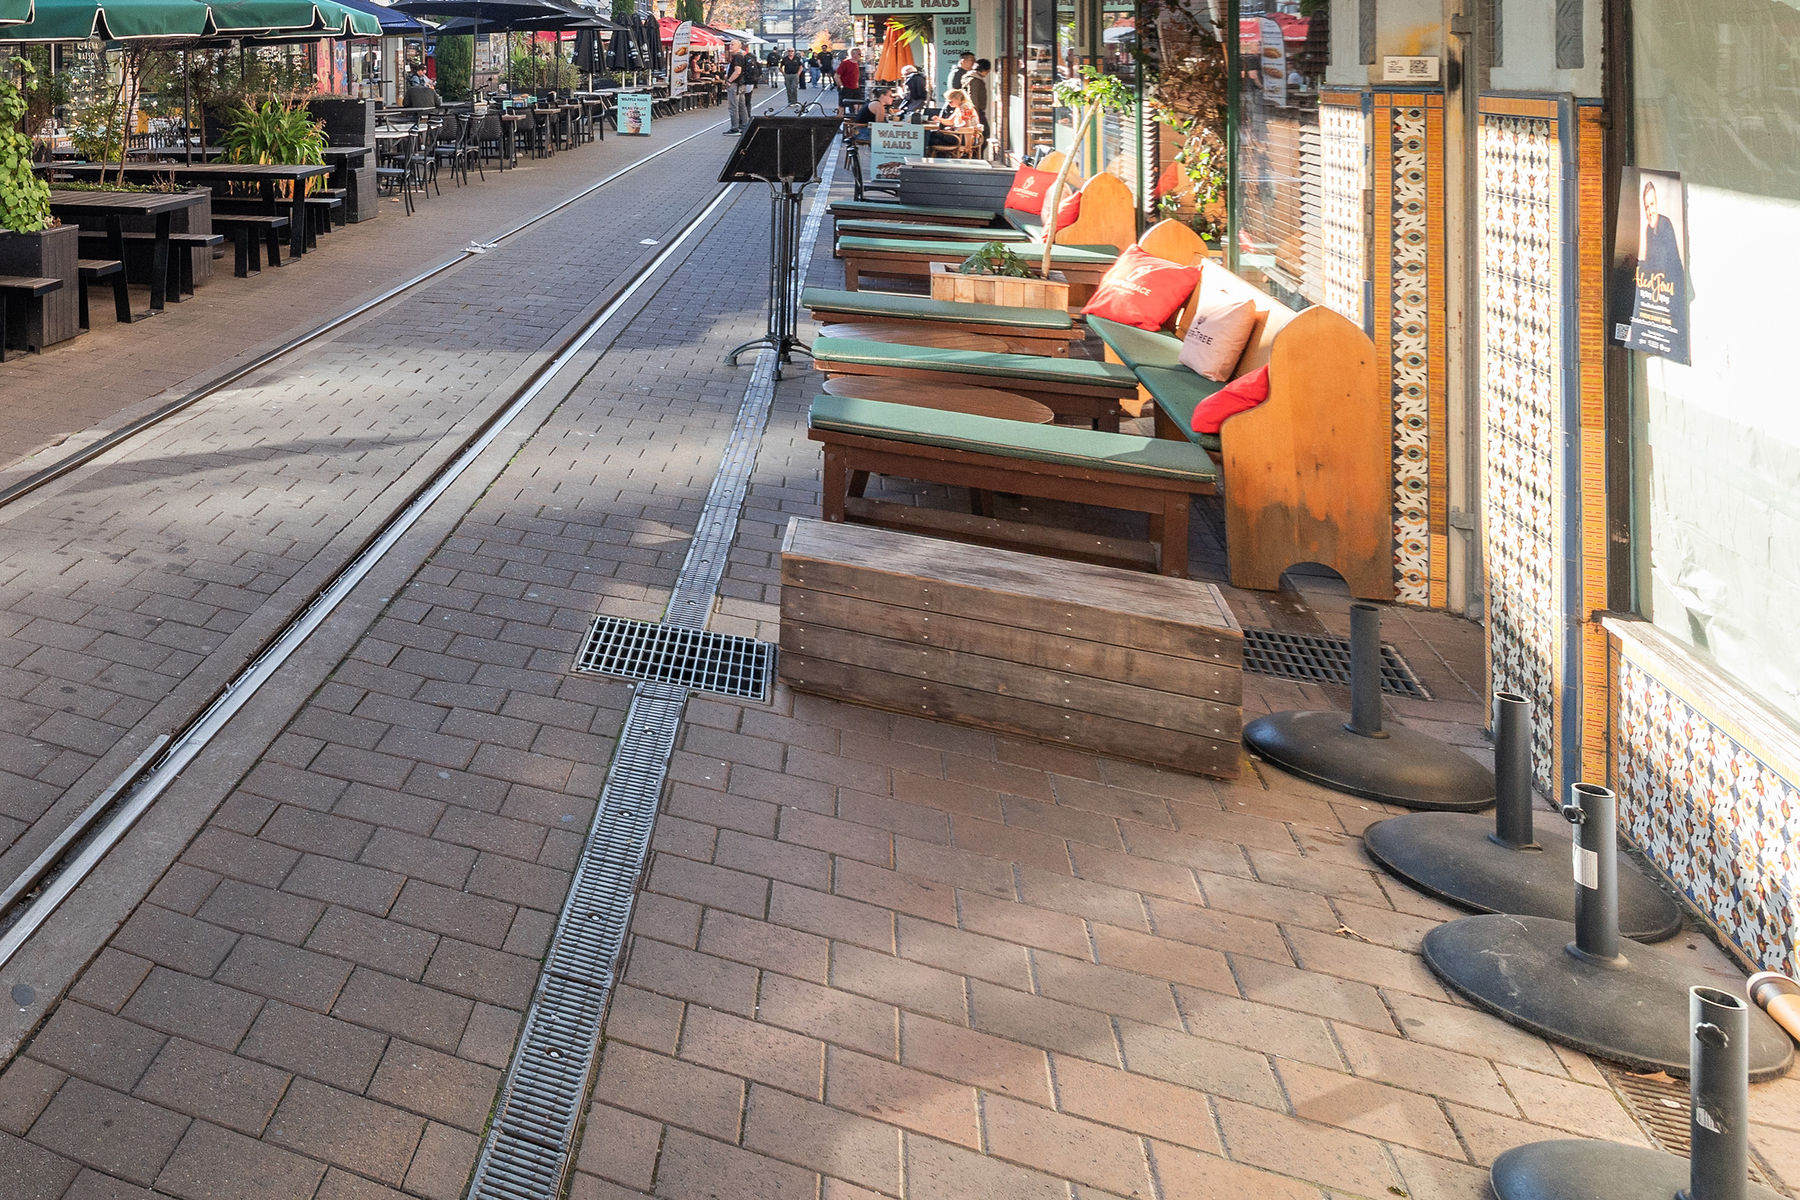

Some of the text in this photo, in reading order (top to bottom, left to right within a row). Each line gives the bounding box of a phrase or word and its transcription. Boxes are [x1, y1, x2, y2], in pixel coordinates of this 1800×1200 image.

[941, 16, 972, 25] WAFFLE
[945, 26, 967, 35] HAUS
[943, 39, 969, 47] Seating
[943, 48, 970, 56] Upsta
[877, 129, 919, 139] WAFFLE
[883, 140, 912, 150] HAUS
